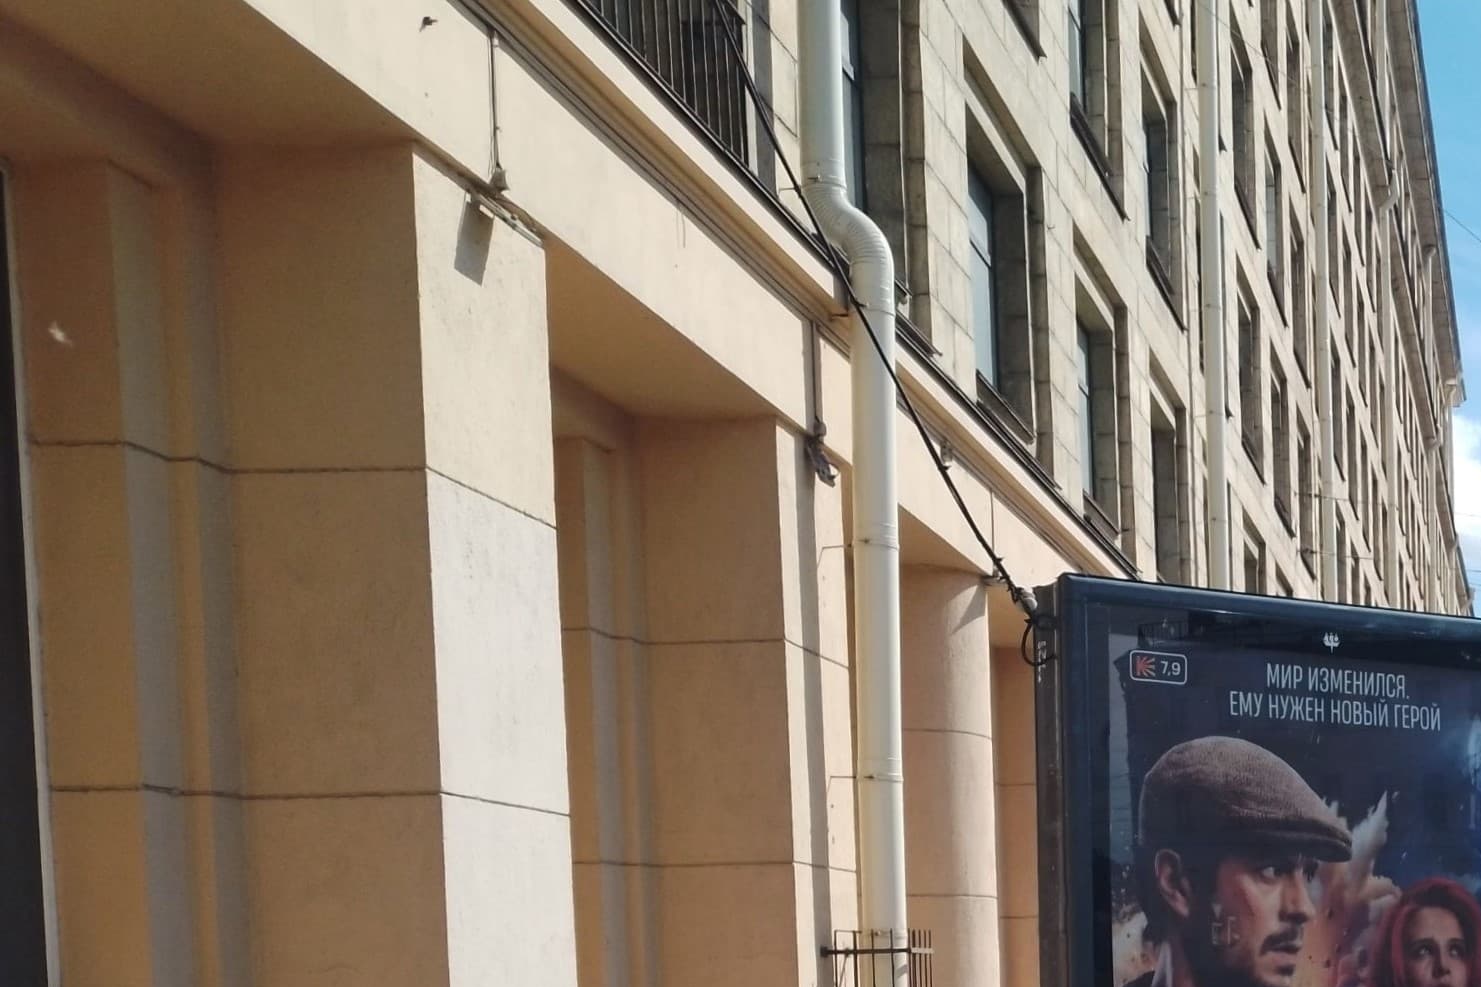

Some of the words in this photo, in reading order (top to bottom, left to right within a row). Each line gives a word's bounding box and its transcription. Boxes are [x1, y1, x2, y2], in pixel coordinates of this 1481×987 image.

[1266, 662, 1303, 689] МИР
[1308, 666, 1410, 700] ИЗМЕНИЛСЯ.
[1229, 690, 1263, 718] ЕМУ
[1268, 693, 1325, 723] НУЖЕН
[1330, 698, 1389, 728] НОВЫЙ
[1394, 702, 1441, 732] ГЕРОЙ
